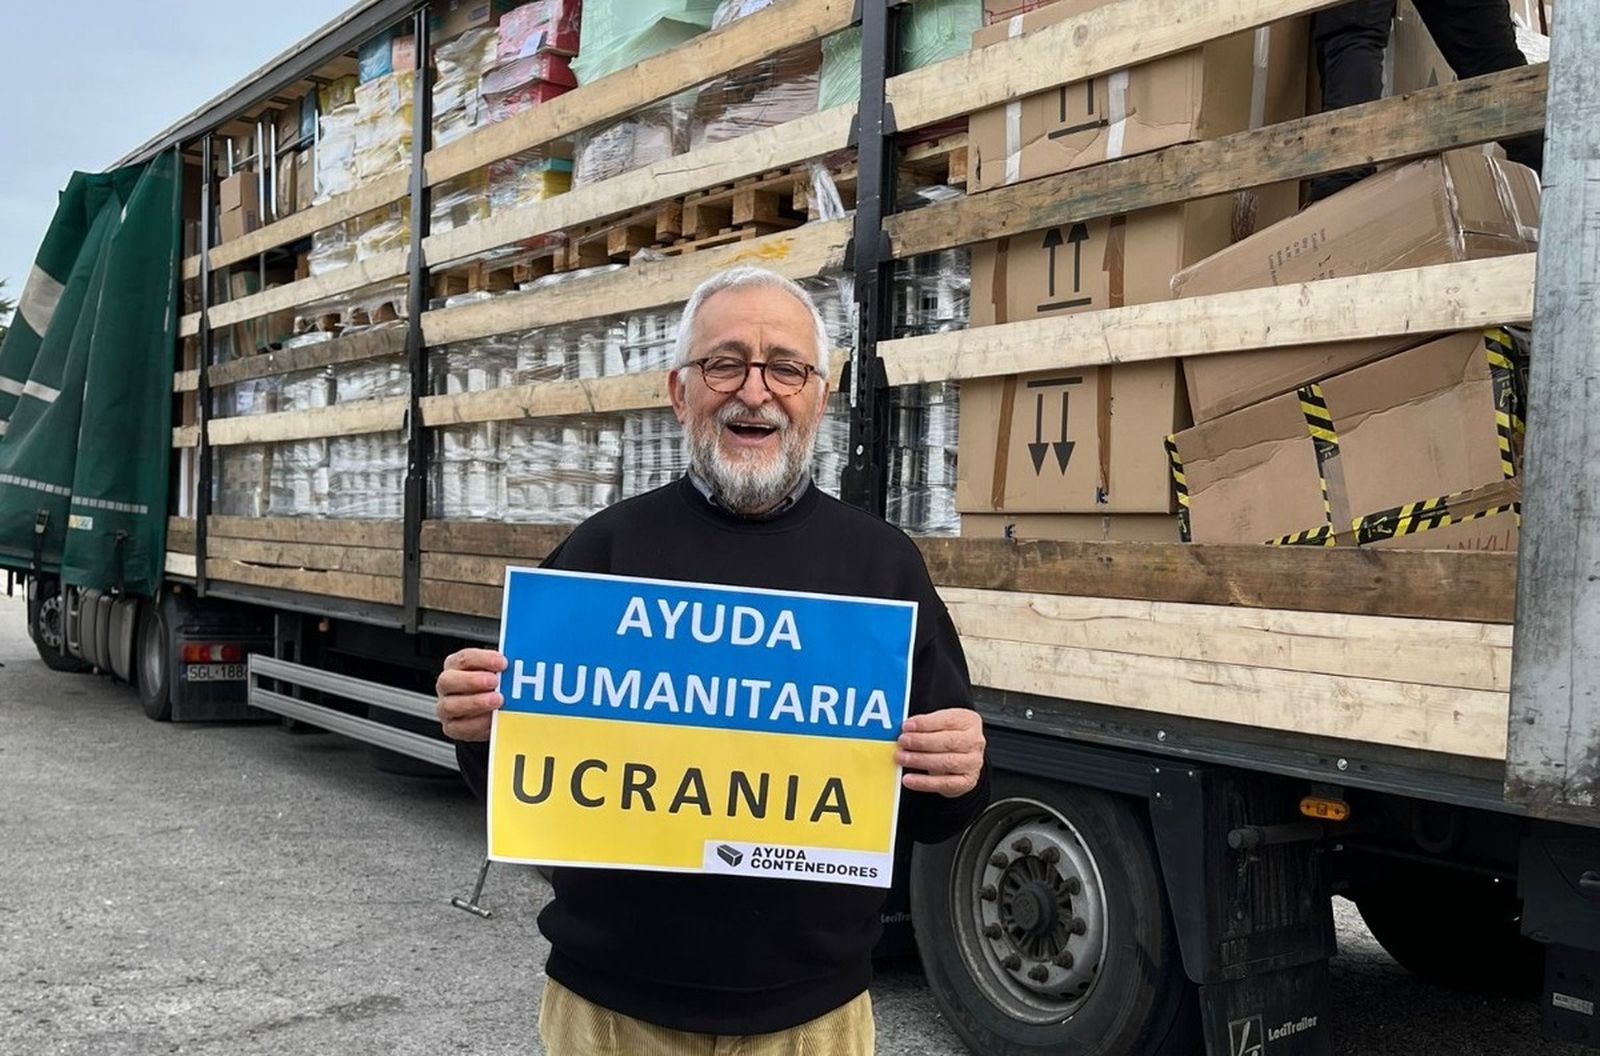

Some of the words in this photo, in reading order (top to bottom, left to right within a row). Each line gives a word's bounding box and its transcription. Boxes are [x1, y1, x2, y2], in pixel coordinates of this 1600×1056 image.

[616, 596, 802, 651] AYUDA
[190, 665, 215, 679] SGL
[221, 665, 248, 678] 188
[510, 659, 893, 729] HUMANITARIA
[512, 755, 852, 825] UCRANIA
[750, 858, 879, 879] CONTENEDORES
[751, 846, 807, 862] AYUDA
